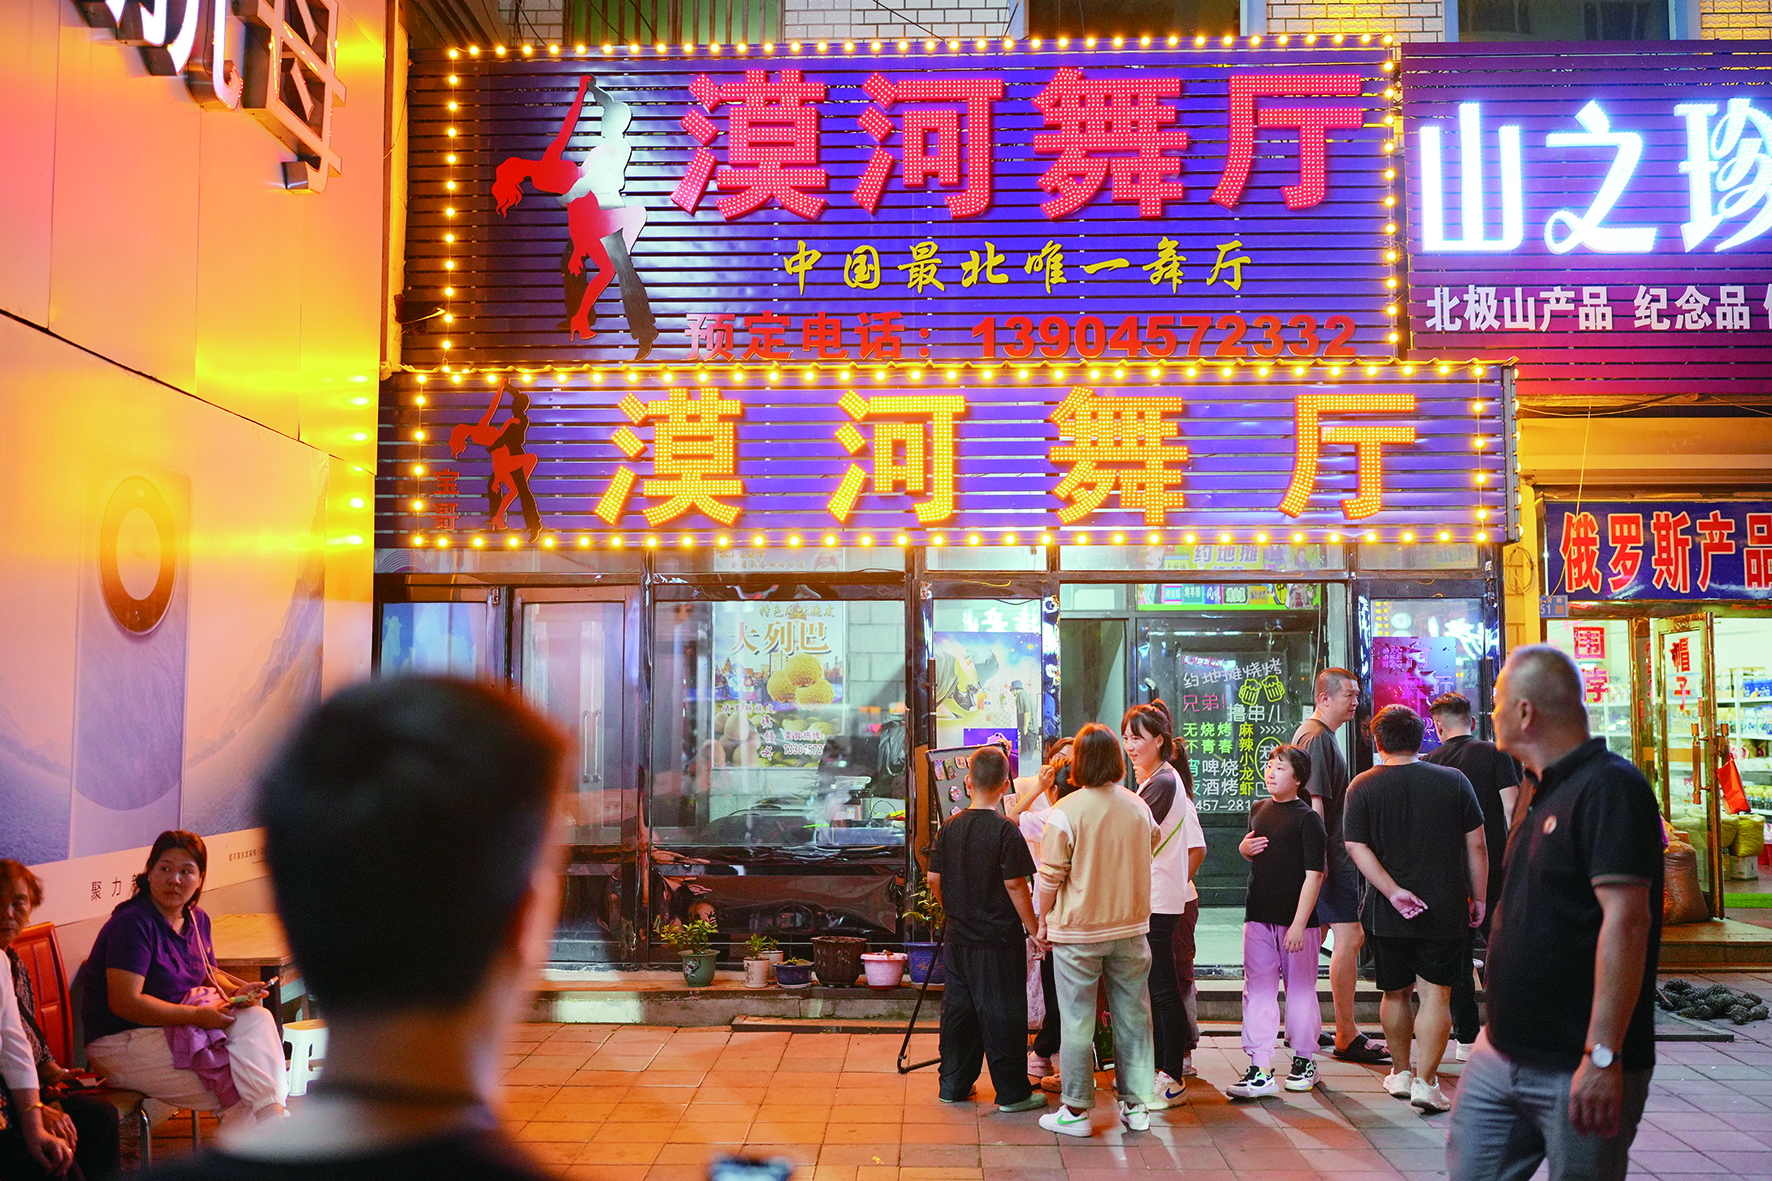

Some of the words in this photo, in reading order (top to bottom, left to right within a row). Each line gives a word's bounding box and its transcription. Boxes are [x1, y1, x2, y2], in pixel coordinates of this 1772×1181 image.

[670, 68, 1363, 220] 漠河舞厅
[1419, 98, 1772, 254] 山之珍
[783, 237, 1253, 294] 中国最北唯一舞厅
[1425, 284, 1613, 332] 北极山产品
[1634, 285, 1751, 331] 纪念品
[971, 316, 1357, 359] 13904572332
[594, 385, 1419, 527] 漠河舞厅
[431, 468, 459, 531] 宝哥
[1193, 544, 1260, 564] 约地摊
[1560, 510, 1772, 594] 俄罗斯产品
[728, 621, 831, 656] 大列巴
[1183, 658, 1282, 689] 约地摊烧烤
[1669, 637, 1691, 712] 帽子
[1183, 722, 1233, 738] 无烧烤
[1227, 703, 1286, 724] 撸串儿
[1185, 739, 1234, 754] 不青春
[1238, 722, 1255, 797] 麻辣小龙虾
[1202, 759, 1220, 796] 啤酒
[1220, 759, 1239, 796] 烧烤
